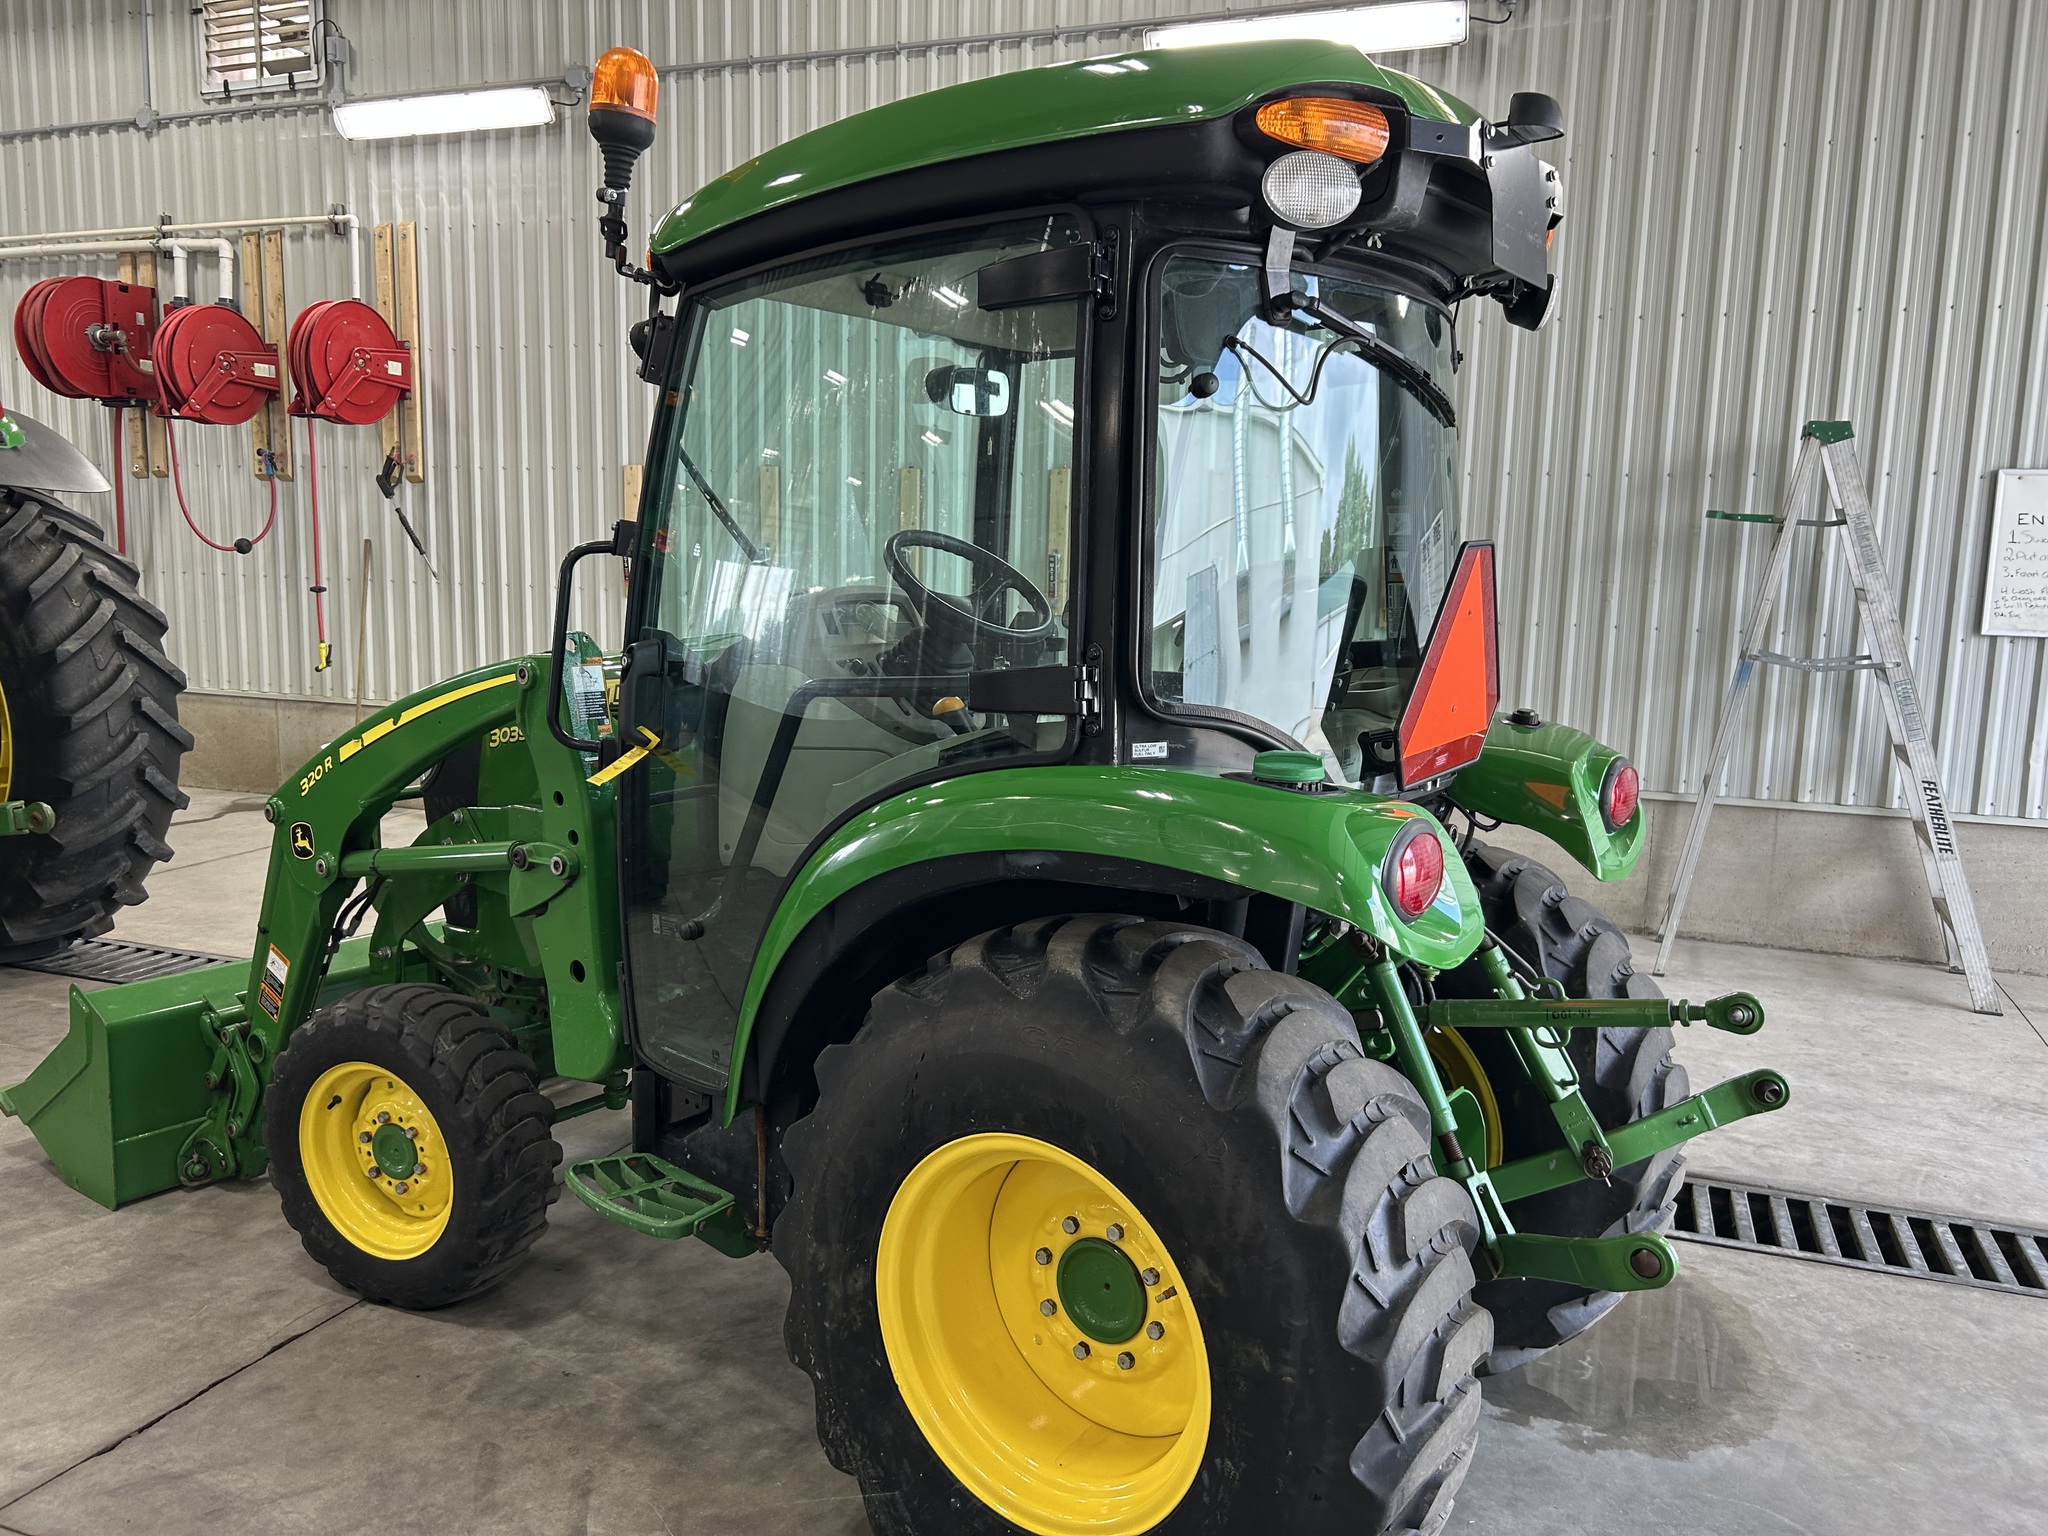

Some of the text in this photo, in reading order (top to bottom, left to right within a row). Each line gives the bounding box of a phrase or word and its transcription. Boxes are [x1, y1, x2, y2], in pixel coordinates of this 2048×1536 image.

[2017, 512, 2048, 525] EN
[299, 754, 333, 797] 320 R
[1921, 780, 1954, 855] FEATHERLITE
